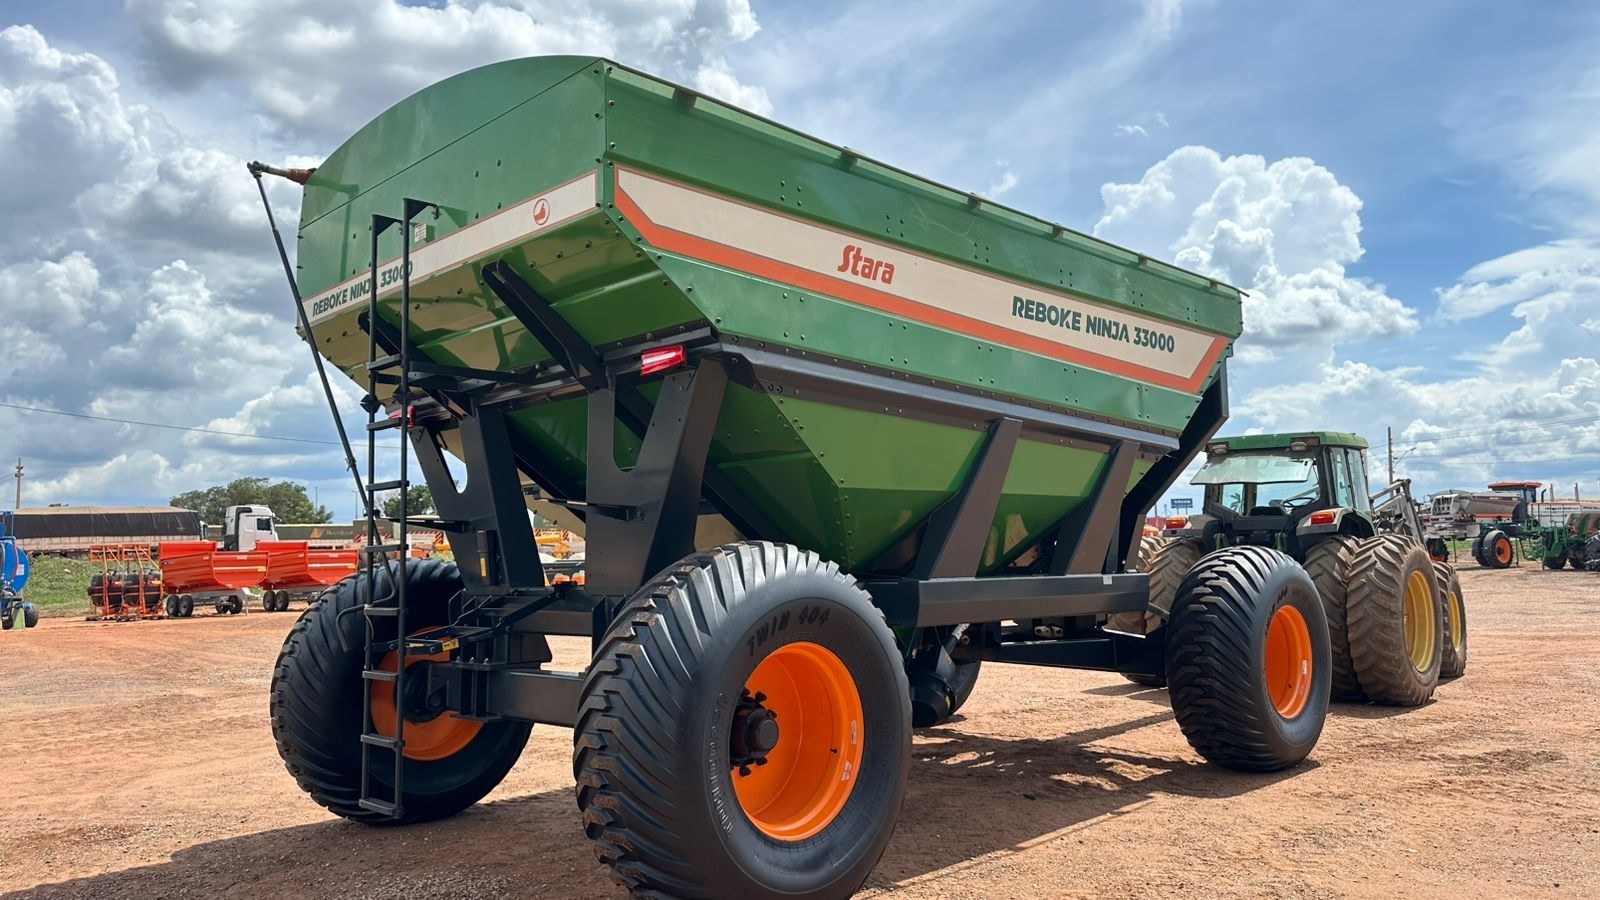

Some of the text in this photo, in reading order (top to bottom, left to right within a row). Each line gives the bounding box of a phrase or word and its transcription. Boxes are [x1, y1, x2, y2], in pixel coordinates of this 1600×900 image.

[837, 244, 895, 285] Stara
[312, 288, 348, 317] REBOKE
[349, 277, 378, 302] NINJ
[1012, 296, 1175, 353] REBOKE NINJA 33000
[747, 605, 831, 657] TWIN 404
